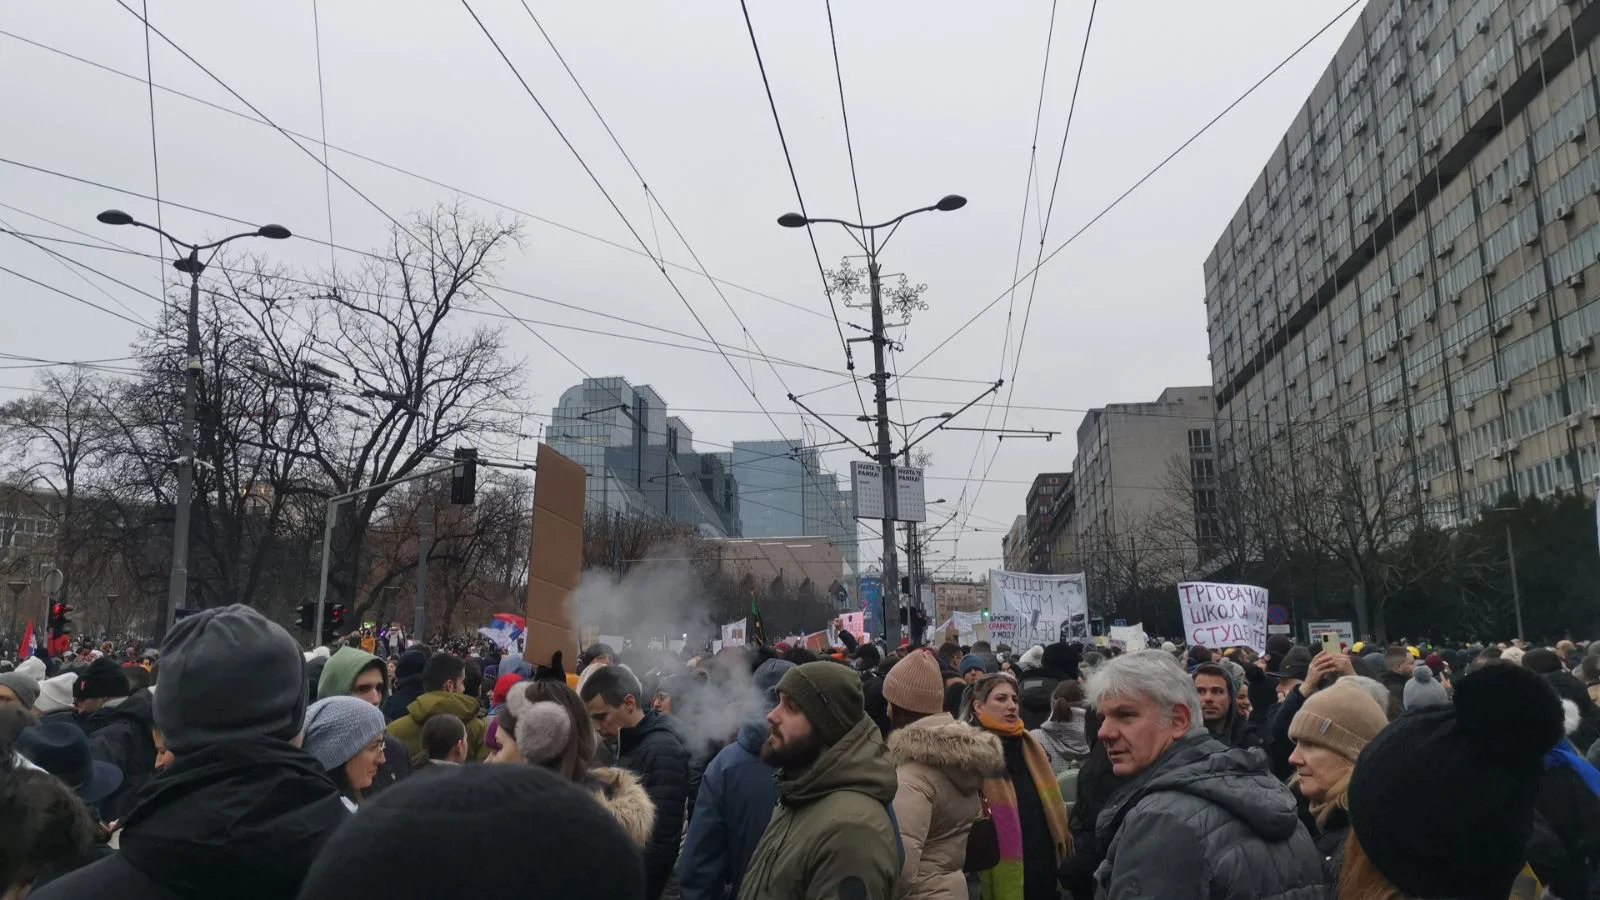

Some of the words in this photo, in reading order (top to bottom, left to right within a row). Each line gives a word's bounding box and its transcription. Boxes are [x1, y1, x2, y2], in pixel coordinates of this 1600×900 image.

[1180, 584, 1266, 610] ТРГОВАЧКА
[1189, 604, 1249, 624] ШКОЛА
[1252, 611, 1265, 630] УЗ
[997, 631, 1015, 639] МОДУ
